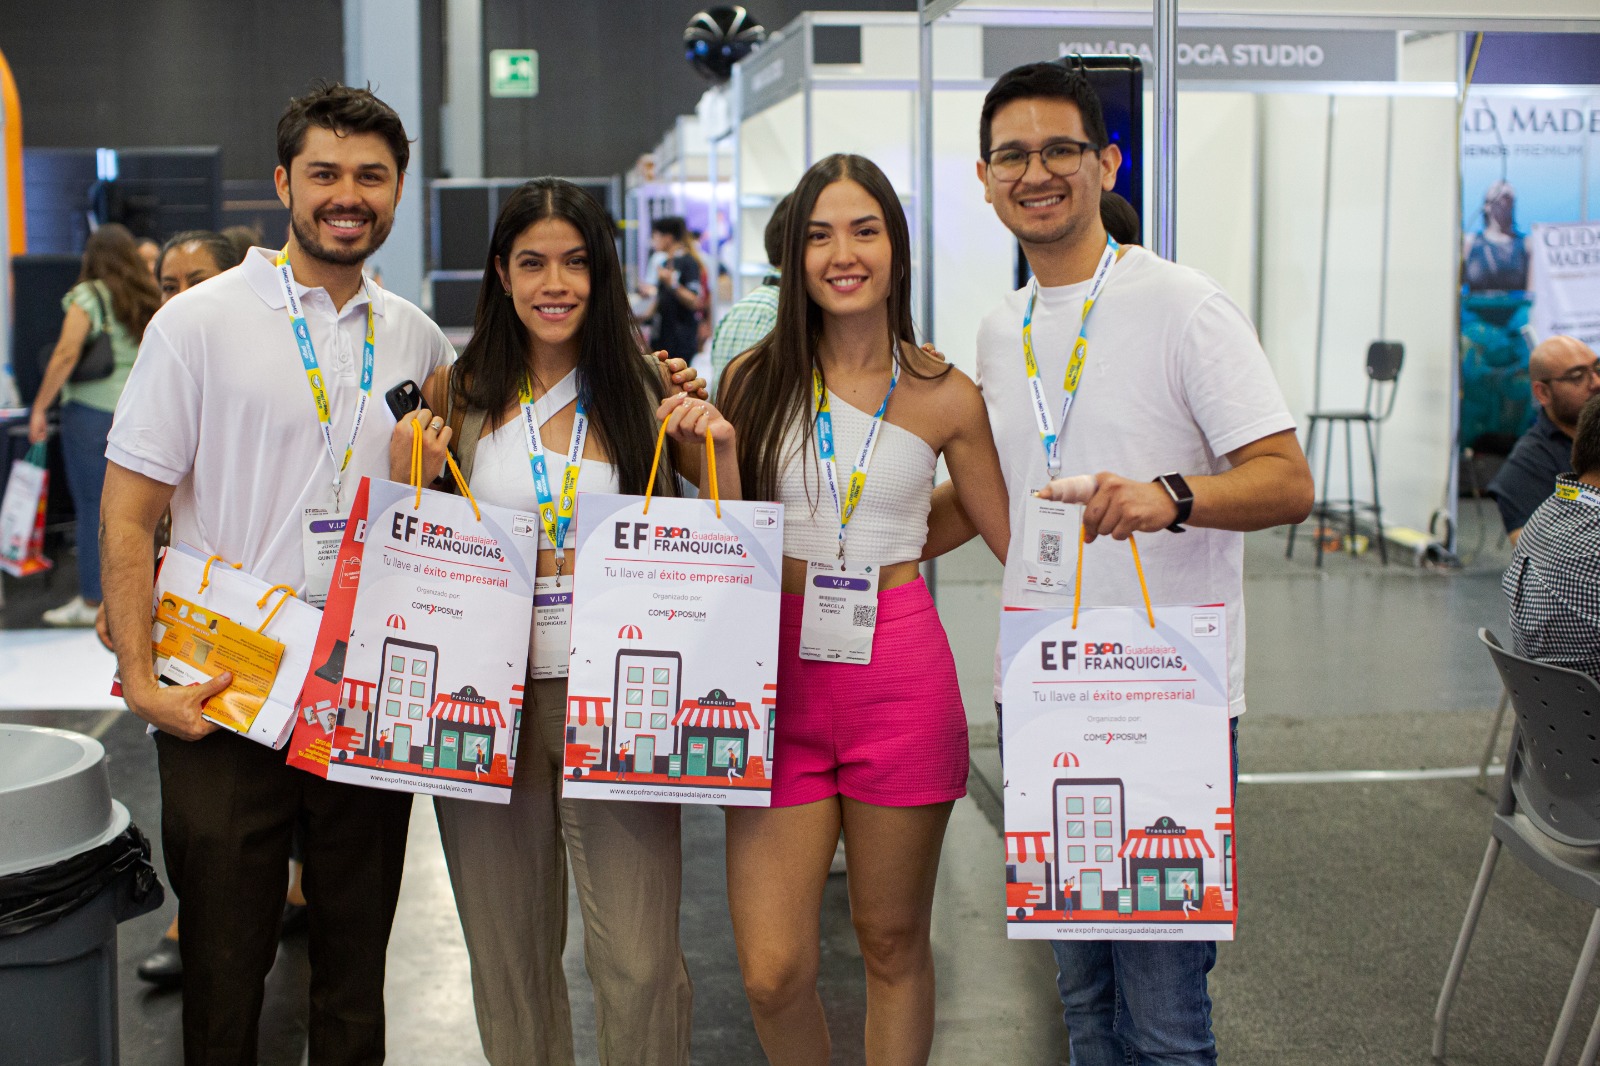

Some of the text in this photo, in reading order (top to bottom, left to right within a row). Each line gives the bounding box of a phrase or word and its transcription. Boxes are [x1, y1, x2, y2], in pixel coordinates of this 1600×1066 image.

[1177, 43, 1230, 65] OGA
[1233, 44, 1324, 67] STUDIO
[392, 511, 419, 542] EF
[454, 531, 498, 546] Guadalajara
[614, 522, 649, 550] EF
[691, 531, 739, 542] Guadalajara
[421, 535, 501, 560] FRANQUICIAS
[654, 539, 743, 556] FRANQUICIAS
[383, 554, 509, 588] Tu llave al éxito empresarial
[604, 566, 753, 584] Tu llave al éxito empresarial
[832, 579, 850, 587] V.I.P
[416, 586, 447, 598] Organizado
[652, 592, 702, 602] Organizado por:
[550, 595, 567, 603] V.I.P
[412, 601, 463, 616] COMEXPOSIUM
[819, 602, 845, 610] MARCELA
[648, 609, 706, 620] COMEXPOSIUM
[1041, 640, 1077, 671] EF
[1125, 645, 1177, 657] Guadalajara
[1084, 655, 1183, 671] FRANQUICIAS
[452, 694, 485, 703] Franquicia
[1033, 689, 1195, 702] Tu llave al éxito empresarial
[1087, 715, 1126, 723] Organizado
[1084, 732, 1147, 744] COMEXPOSIUM
[370, 775, 473, 794] www.expofranquiciasguadalajara.com
[609, 788, 727, 799] www.expofranquiciasguadalajara.com
[1056, 927, 1184, 935] www.expofranquiciasguadalajara.com
